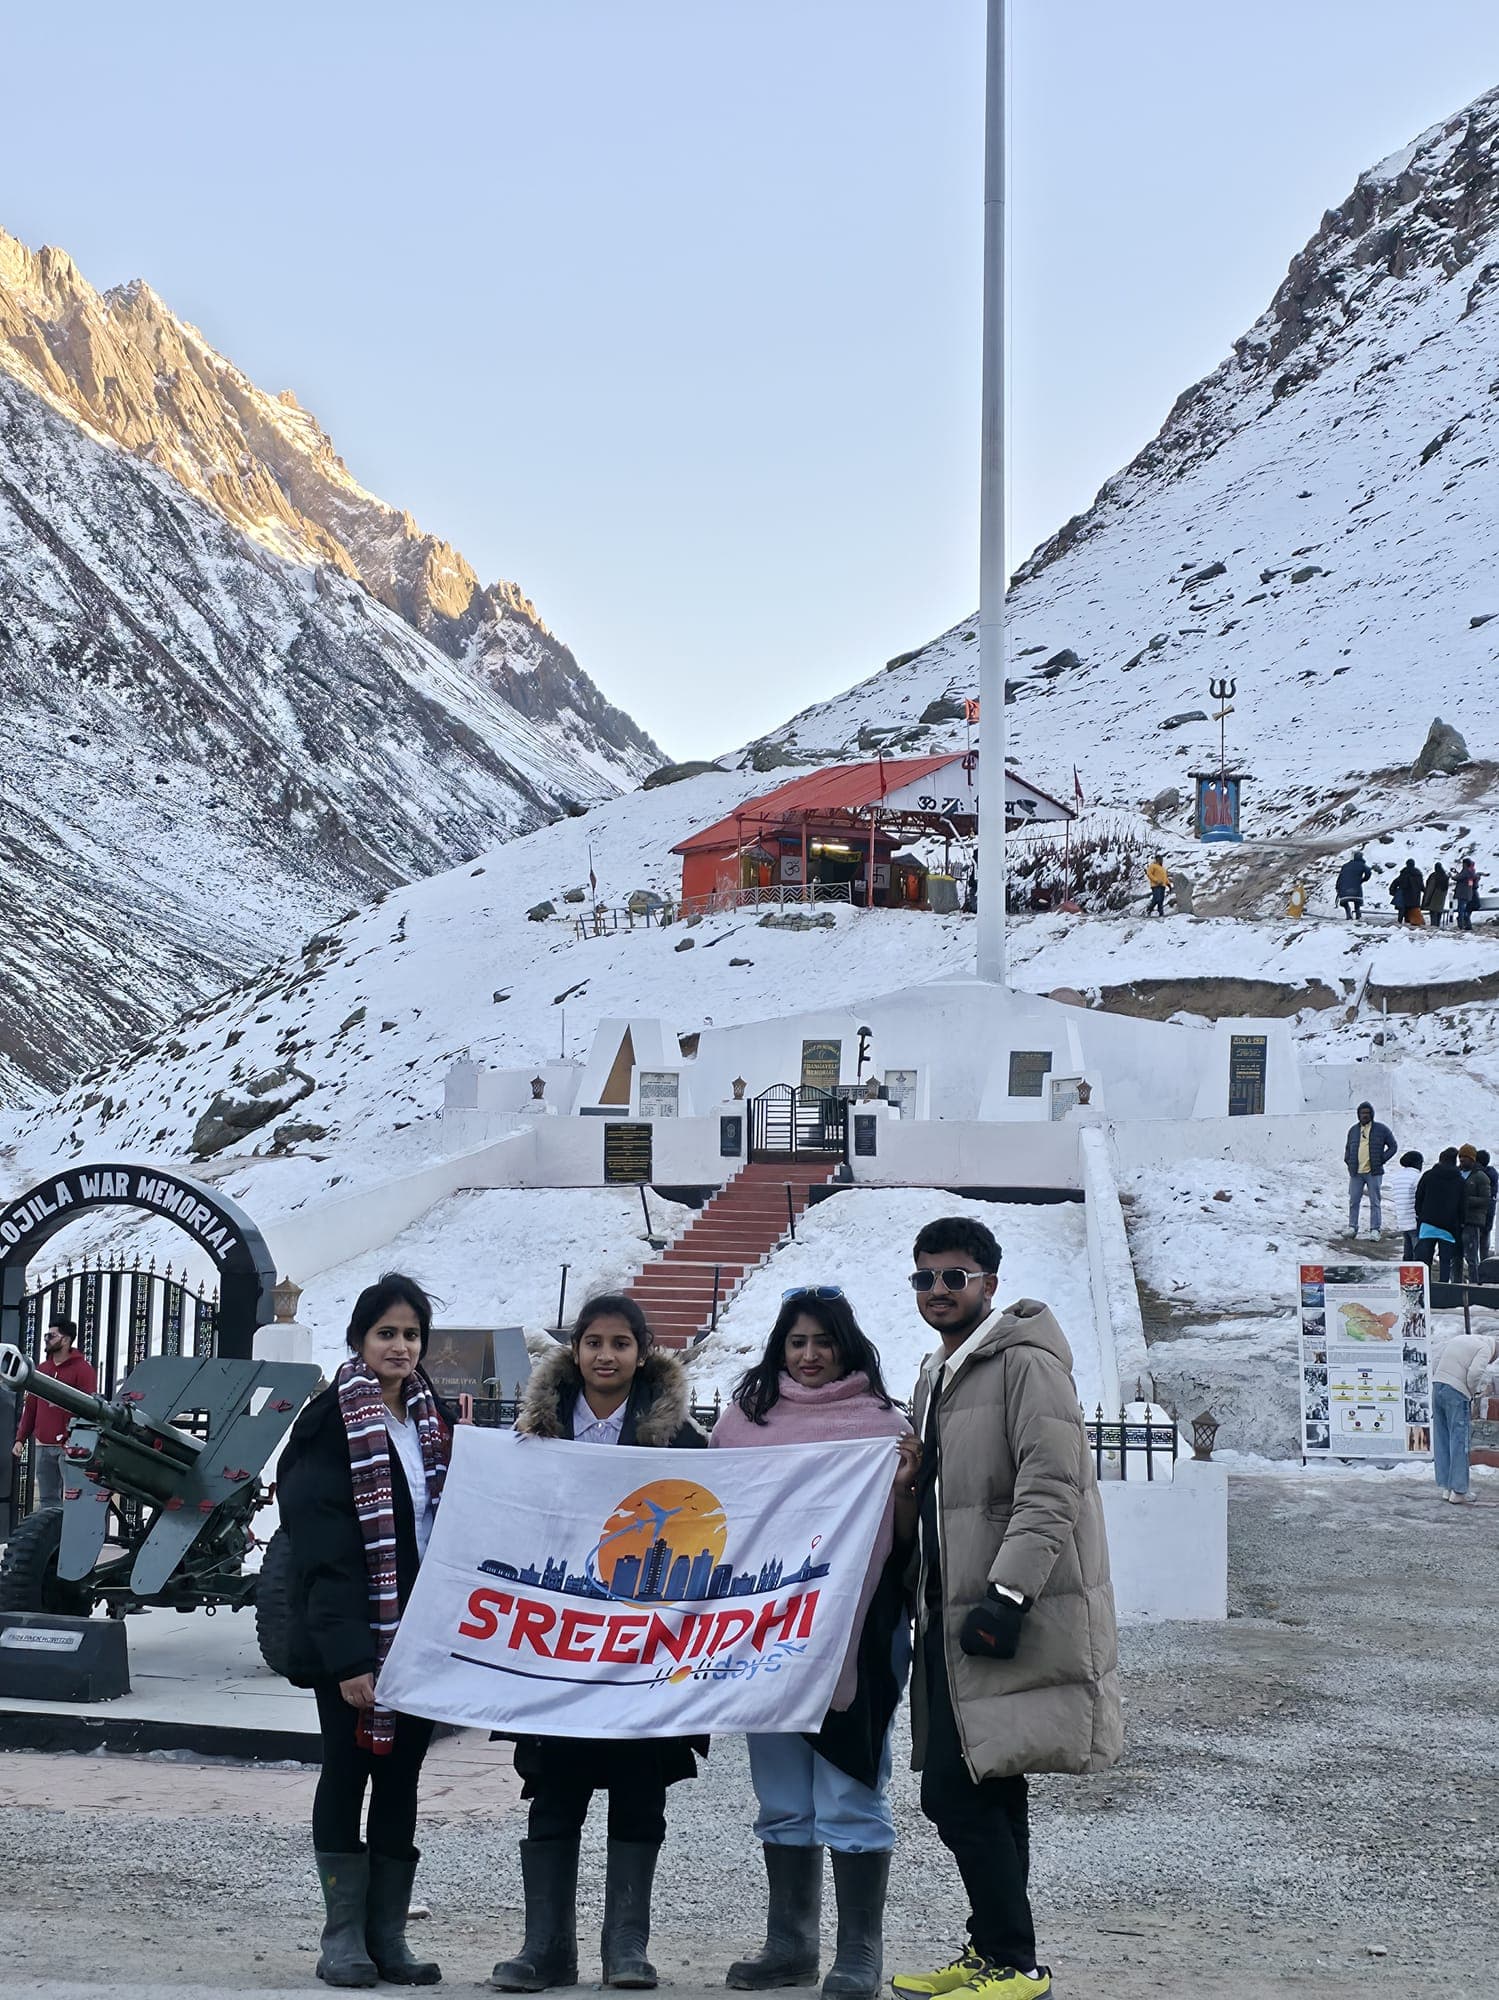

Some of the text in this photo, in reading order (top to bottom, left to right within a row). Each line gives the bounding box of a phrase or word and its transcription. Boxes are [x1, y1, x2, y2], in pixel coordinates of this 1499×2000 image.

[79, 1172, 130, 1199] WAR
[136, 1175, 239, 1260] MEMORIAL
[458, 1587, 821, 1665] SREENIDHI
[648, 1653, 783, 1690] Holidays
